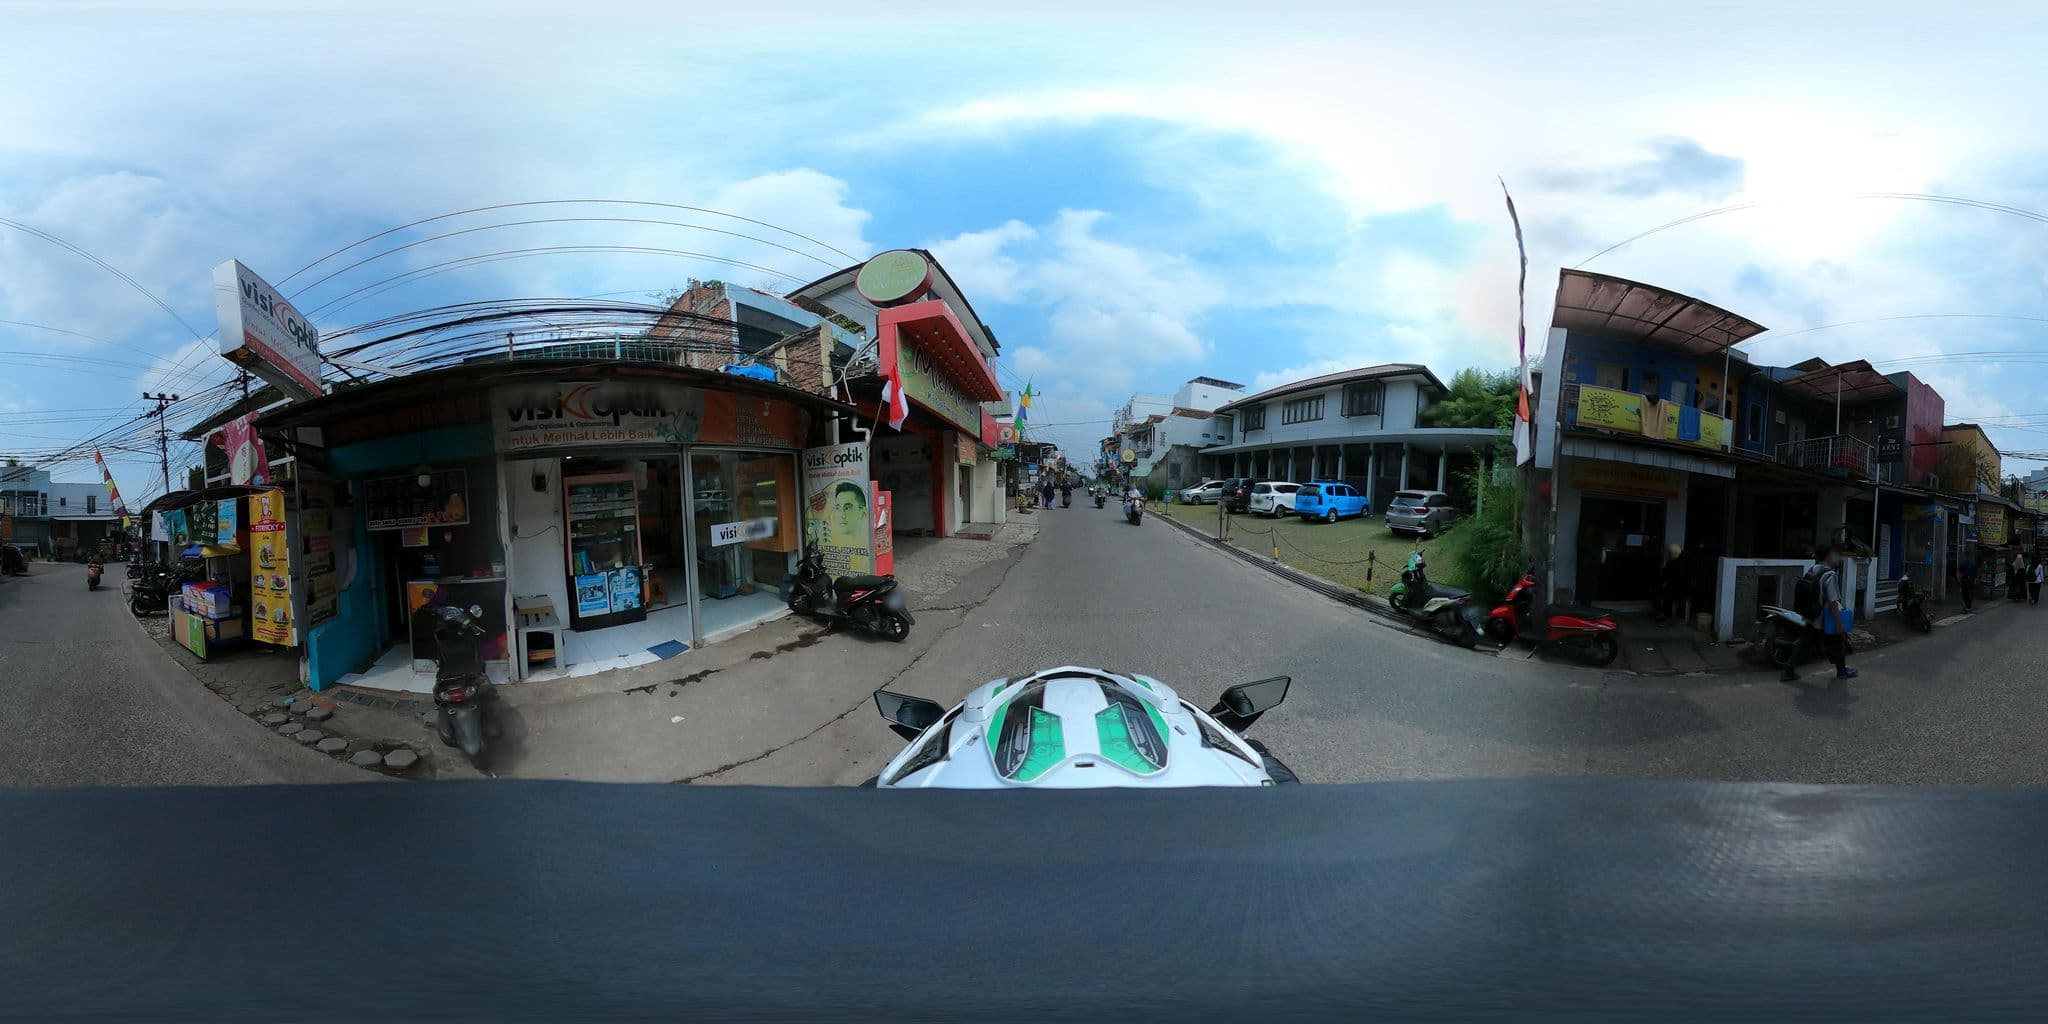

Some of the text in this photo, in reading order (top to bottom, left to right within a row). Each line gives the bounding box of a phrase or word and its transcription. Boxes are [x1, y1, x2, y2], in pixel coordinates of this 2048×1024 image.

[807, 447, 863, 468] visi optik
[719, 525, 738, 540] visi
